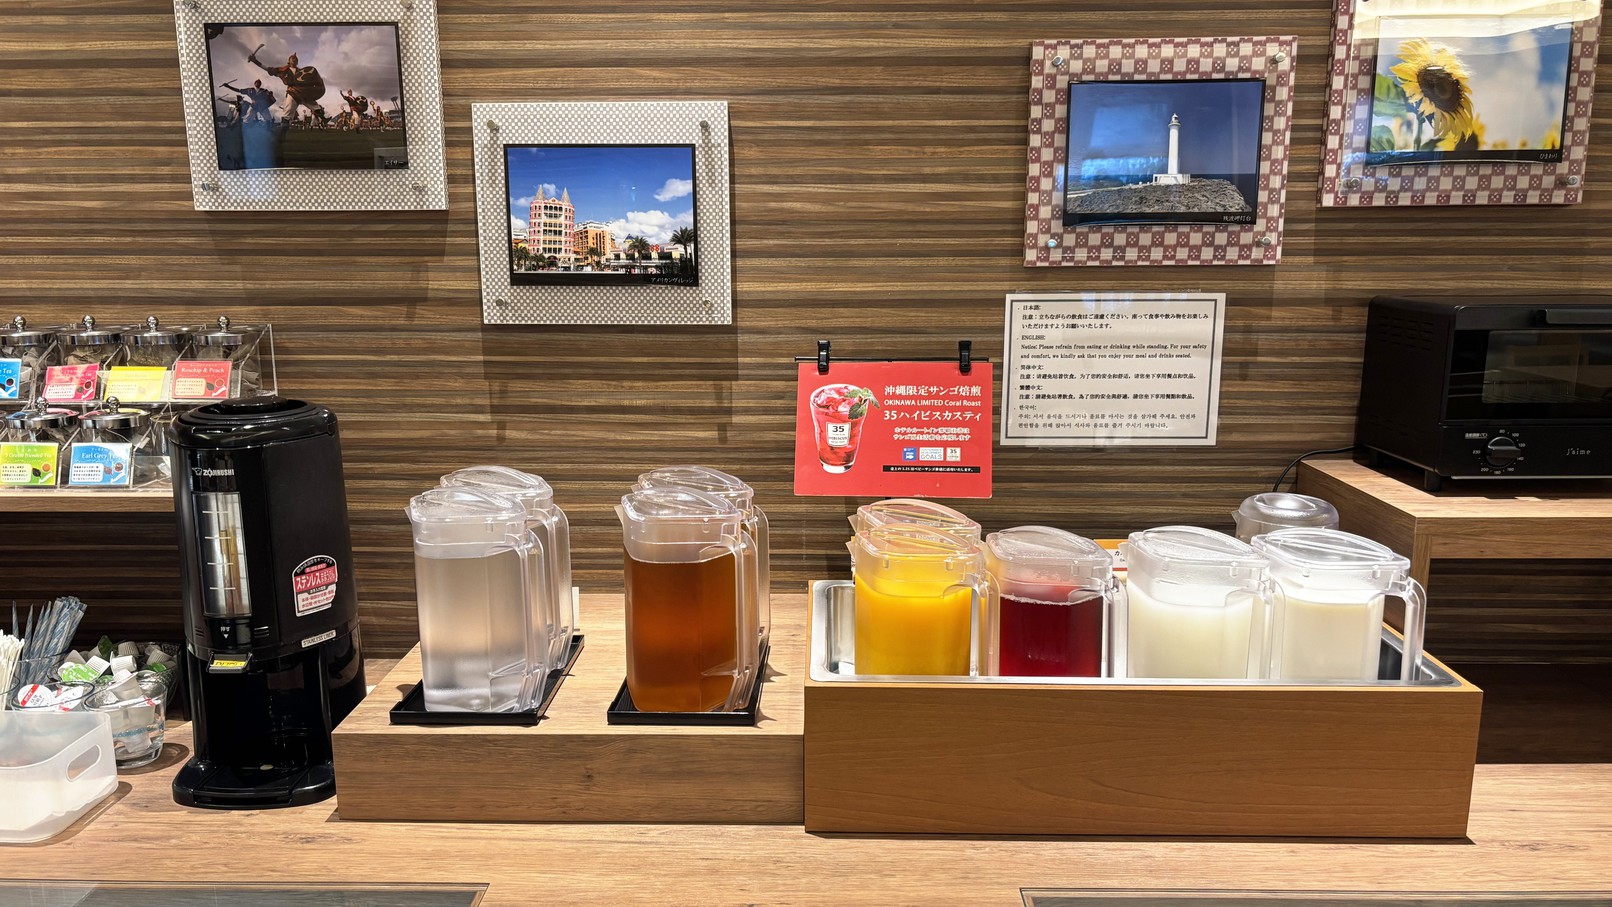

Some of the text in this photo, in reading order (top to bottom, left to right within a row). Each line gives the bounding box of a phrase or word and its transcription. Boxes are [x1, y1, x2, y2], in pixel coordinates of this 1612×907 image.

[884, 385, 982, 396] 沖縄限定サンゴ焙煎
